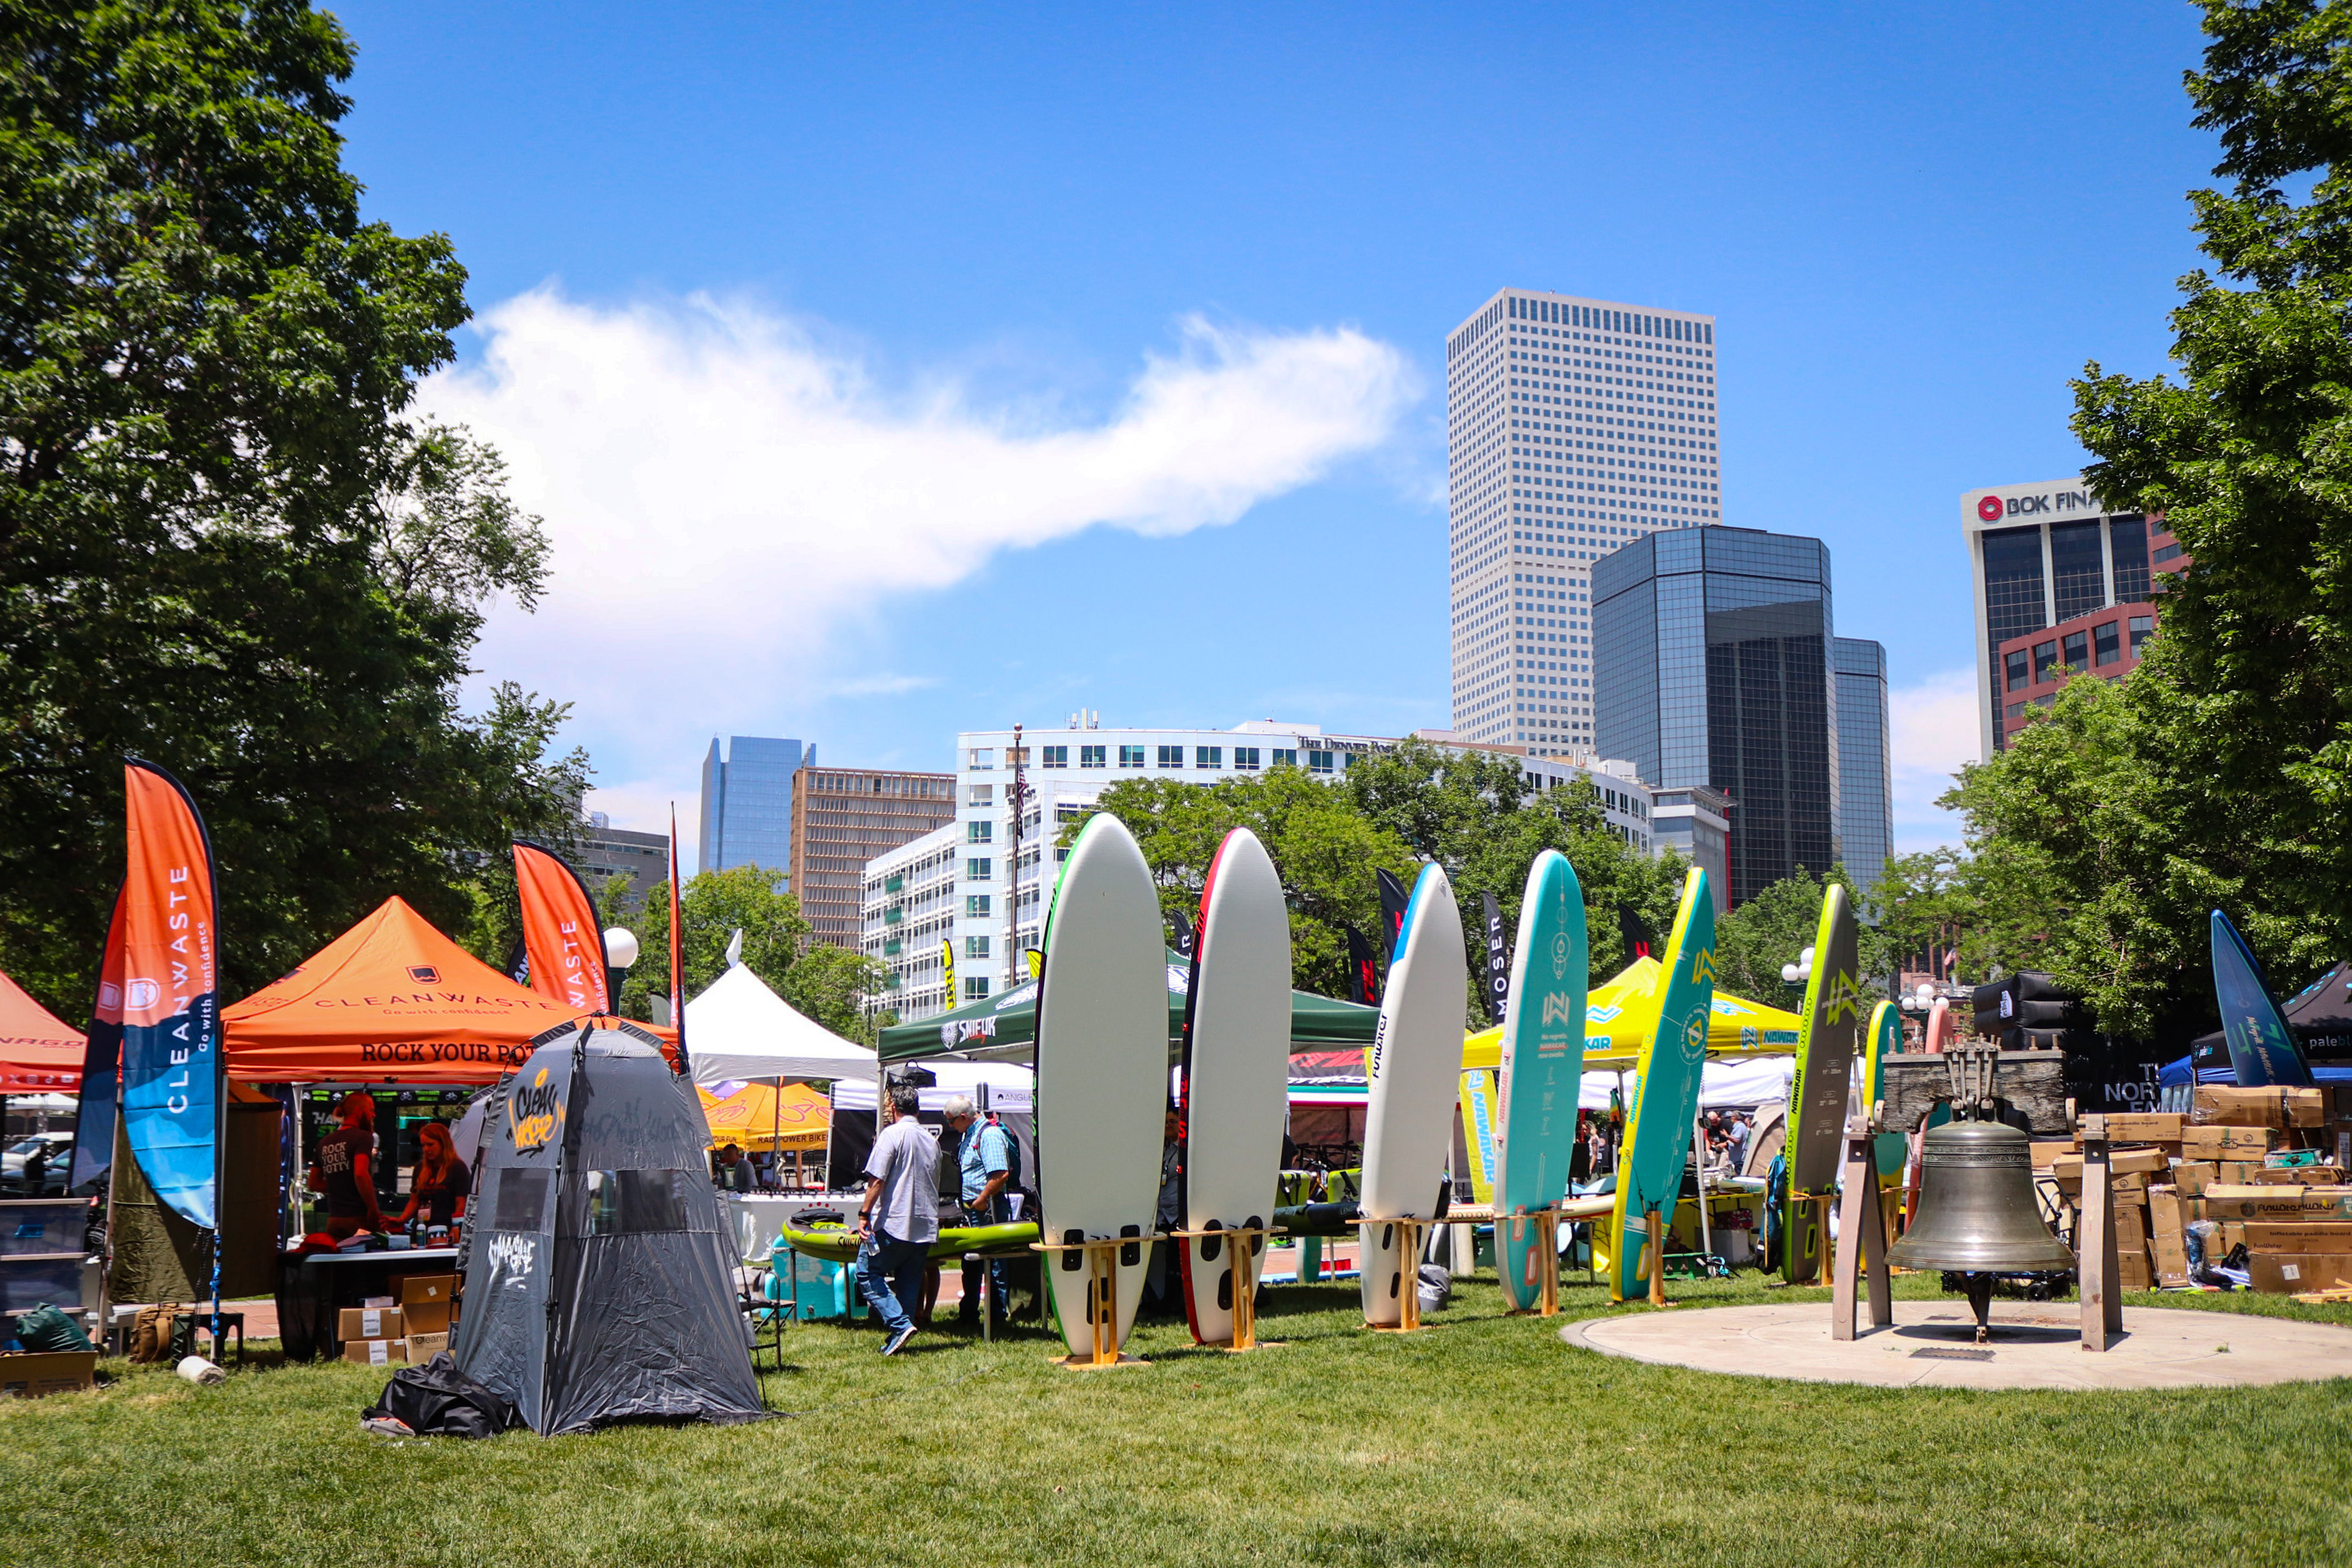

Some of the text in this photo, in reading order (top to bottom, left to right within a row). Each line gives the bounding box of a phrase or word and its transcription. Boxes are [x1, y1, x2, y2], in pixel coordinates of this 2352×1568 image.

[2006, 495, 2048, 515] BOK
[1298, 735, 1321, 748] THE
[1324, 738, 1369, 751] DENVER
[561, 921, 585, 1008] WASTE
[1491, 916, 1508, 1016] MOSER
[167, 866, 190, 1114] CLEANWASTE
[197, 922, 212, 1052] Go with confidence
[314, 992, 558, 1011] CLEANWASTE
[442, 1008, 512, 1016] confidence
[361, 1043, 423, 1062] ROCK
[429, 1043, 492, 1062] YOUR
[1498, 1071, 1509, 1123] NAWAKAR
[1629, 1075, 1643, 1124] NAWAKAR
[1791, 1069, 1802, 1115] NAWAKAR
[2105, 1082, 2159, 1102] NOR
[2130, 1101, 2160, 1113] FA
[322, 1141, 347, 1154] ROCK
[758, 1133, 829, 1144] RAD POWER BIKE
[1472, 1092, 1495, 1184] NAWAKAR
